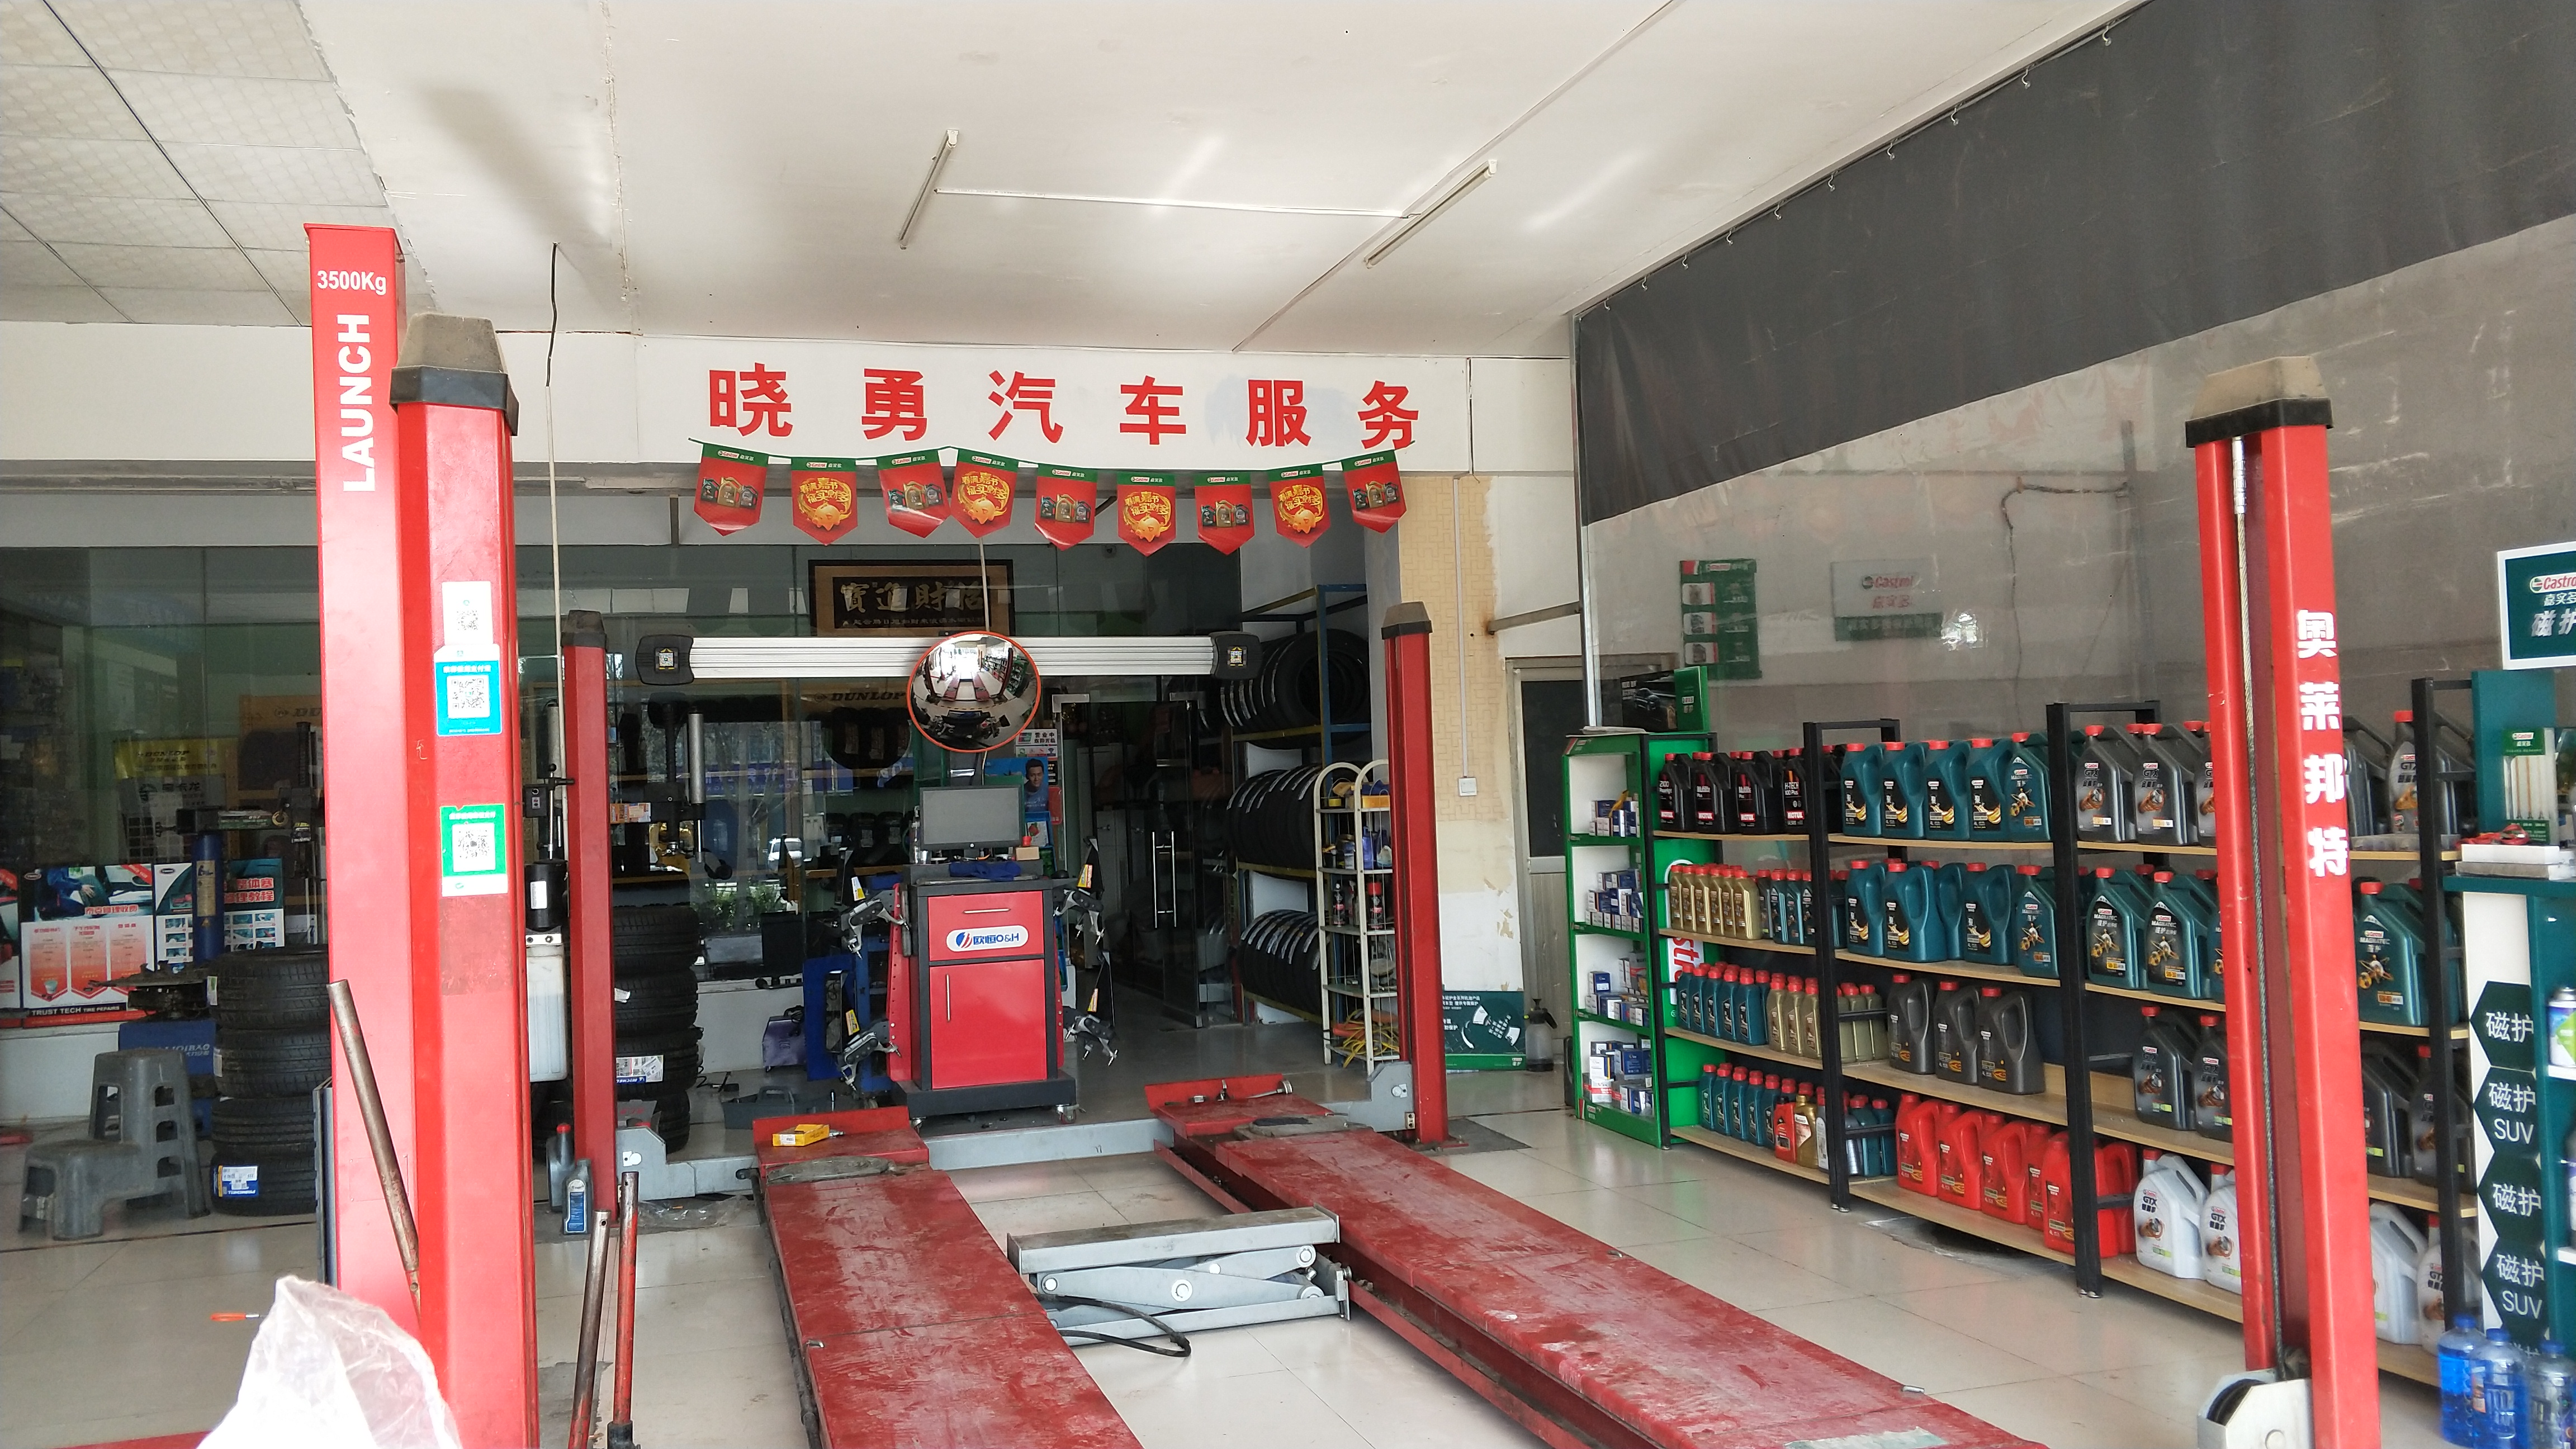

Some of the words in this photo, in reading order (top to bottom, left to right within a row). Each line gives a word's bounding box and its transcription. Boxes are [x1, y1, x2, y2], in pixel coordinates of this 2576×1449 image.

[317, 271, 386, 296] 3500Kg
[338, 314, 375, 492] LAUNCH
[709, 362, 1418, 449] 晓勇汽车服务
[2531, 608, 2576, 637] 磁护
[831, 692, 906, 701] DUNLOP
[2296, 609, 2349, 878] 奥莱邦特
[2084, 769, 2100, 777] GTX
[2142, 769, 2159, 778] GTX
[2485, 1011, 2534, 1043] 磁护
[2489, 1082, 2536, 1113] 磁护
[2494, 1118, 2534, 1144] SUV
[2143, 1196, 2158, 1205] GTX
[2493, 1183, 2542, 1217] 磁护
[2210, 1213, 2226, 1223] GTX
[2497, 1253, 2544, 1287] 磁护
[2502, 1290, 2543, 1319] SUV
